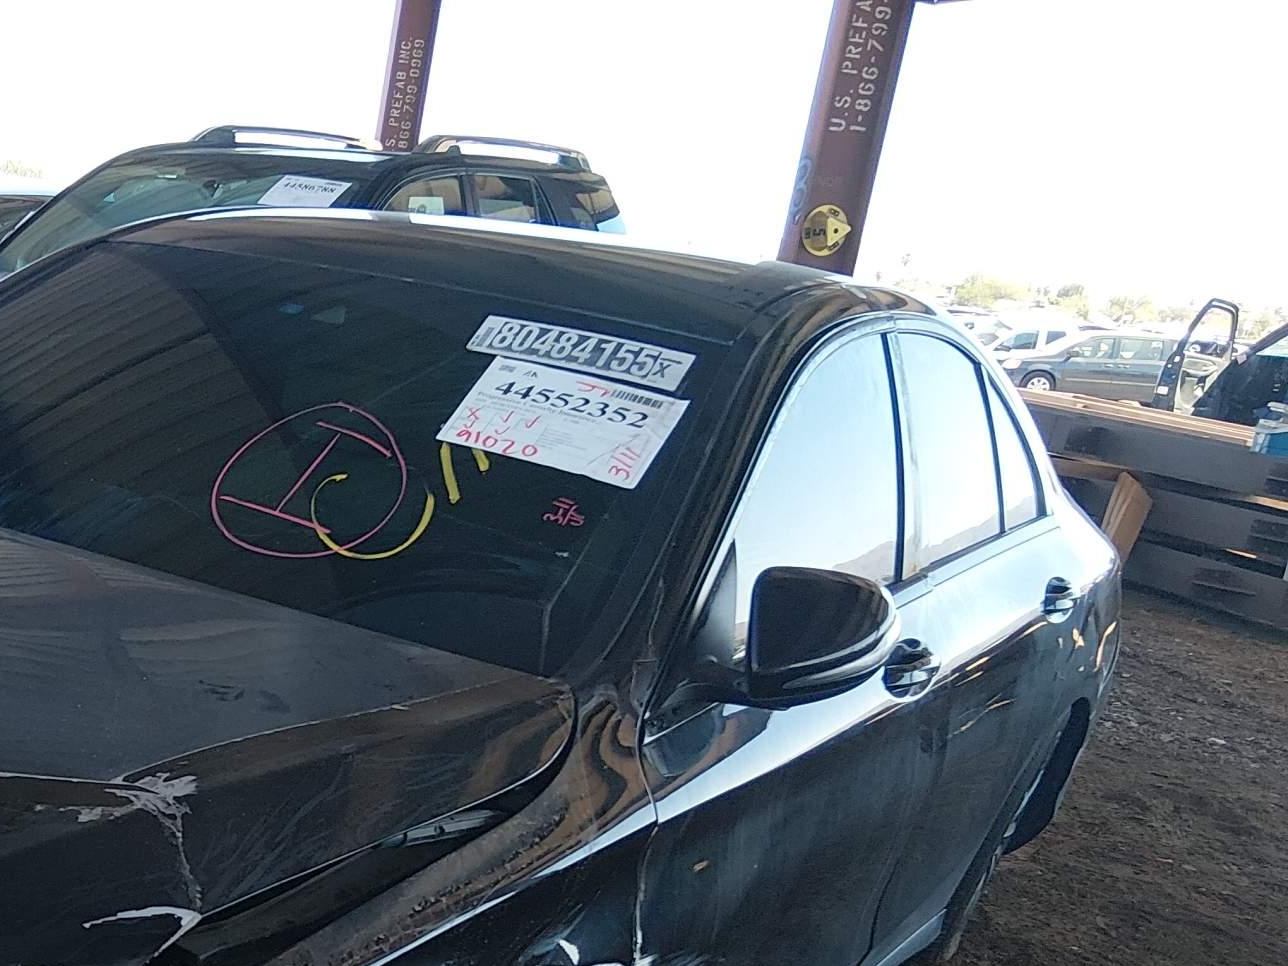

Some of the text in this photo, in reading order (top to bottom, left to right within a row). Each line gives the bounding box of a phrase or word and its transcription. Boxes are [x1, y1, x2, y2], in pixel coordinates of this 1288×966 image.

[388, 71, 407, 126] PREFAB
[398, 36, 413, 64] INC.
[829, 89, 853, 131] U.S.
[490, 321, 661, 379] 80484155
[495, 381, 649, 428] 44552352
